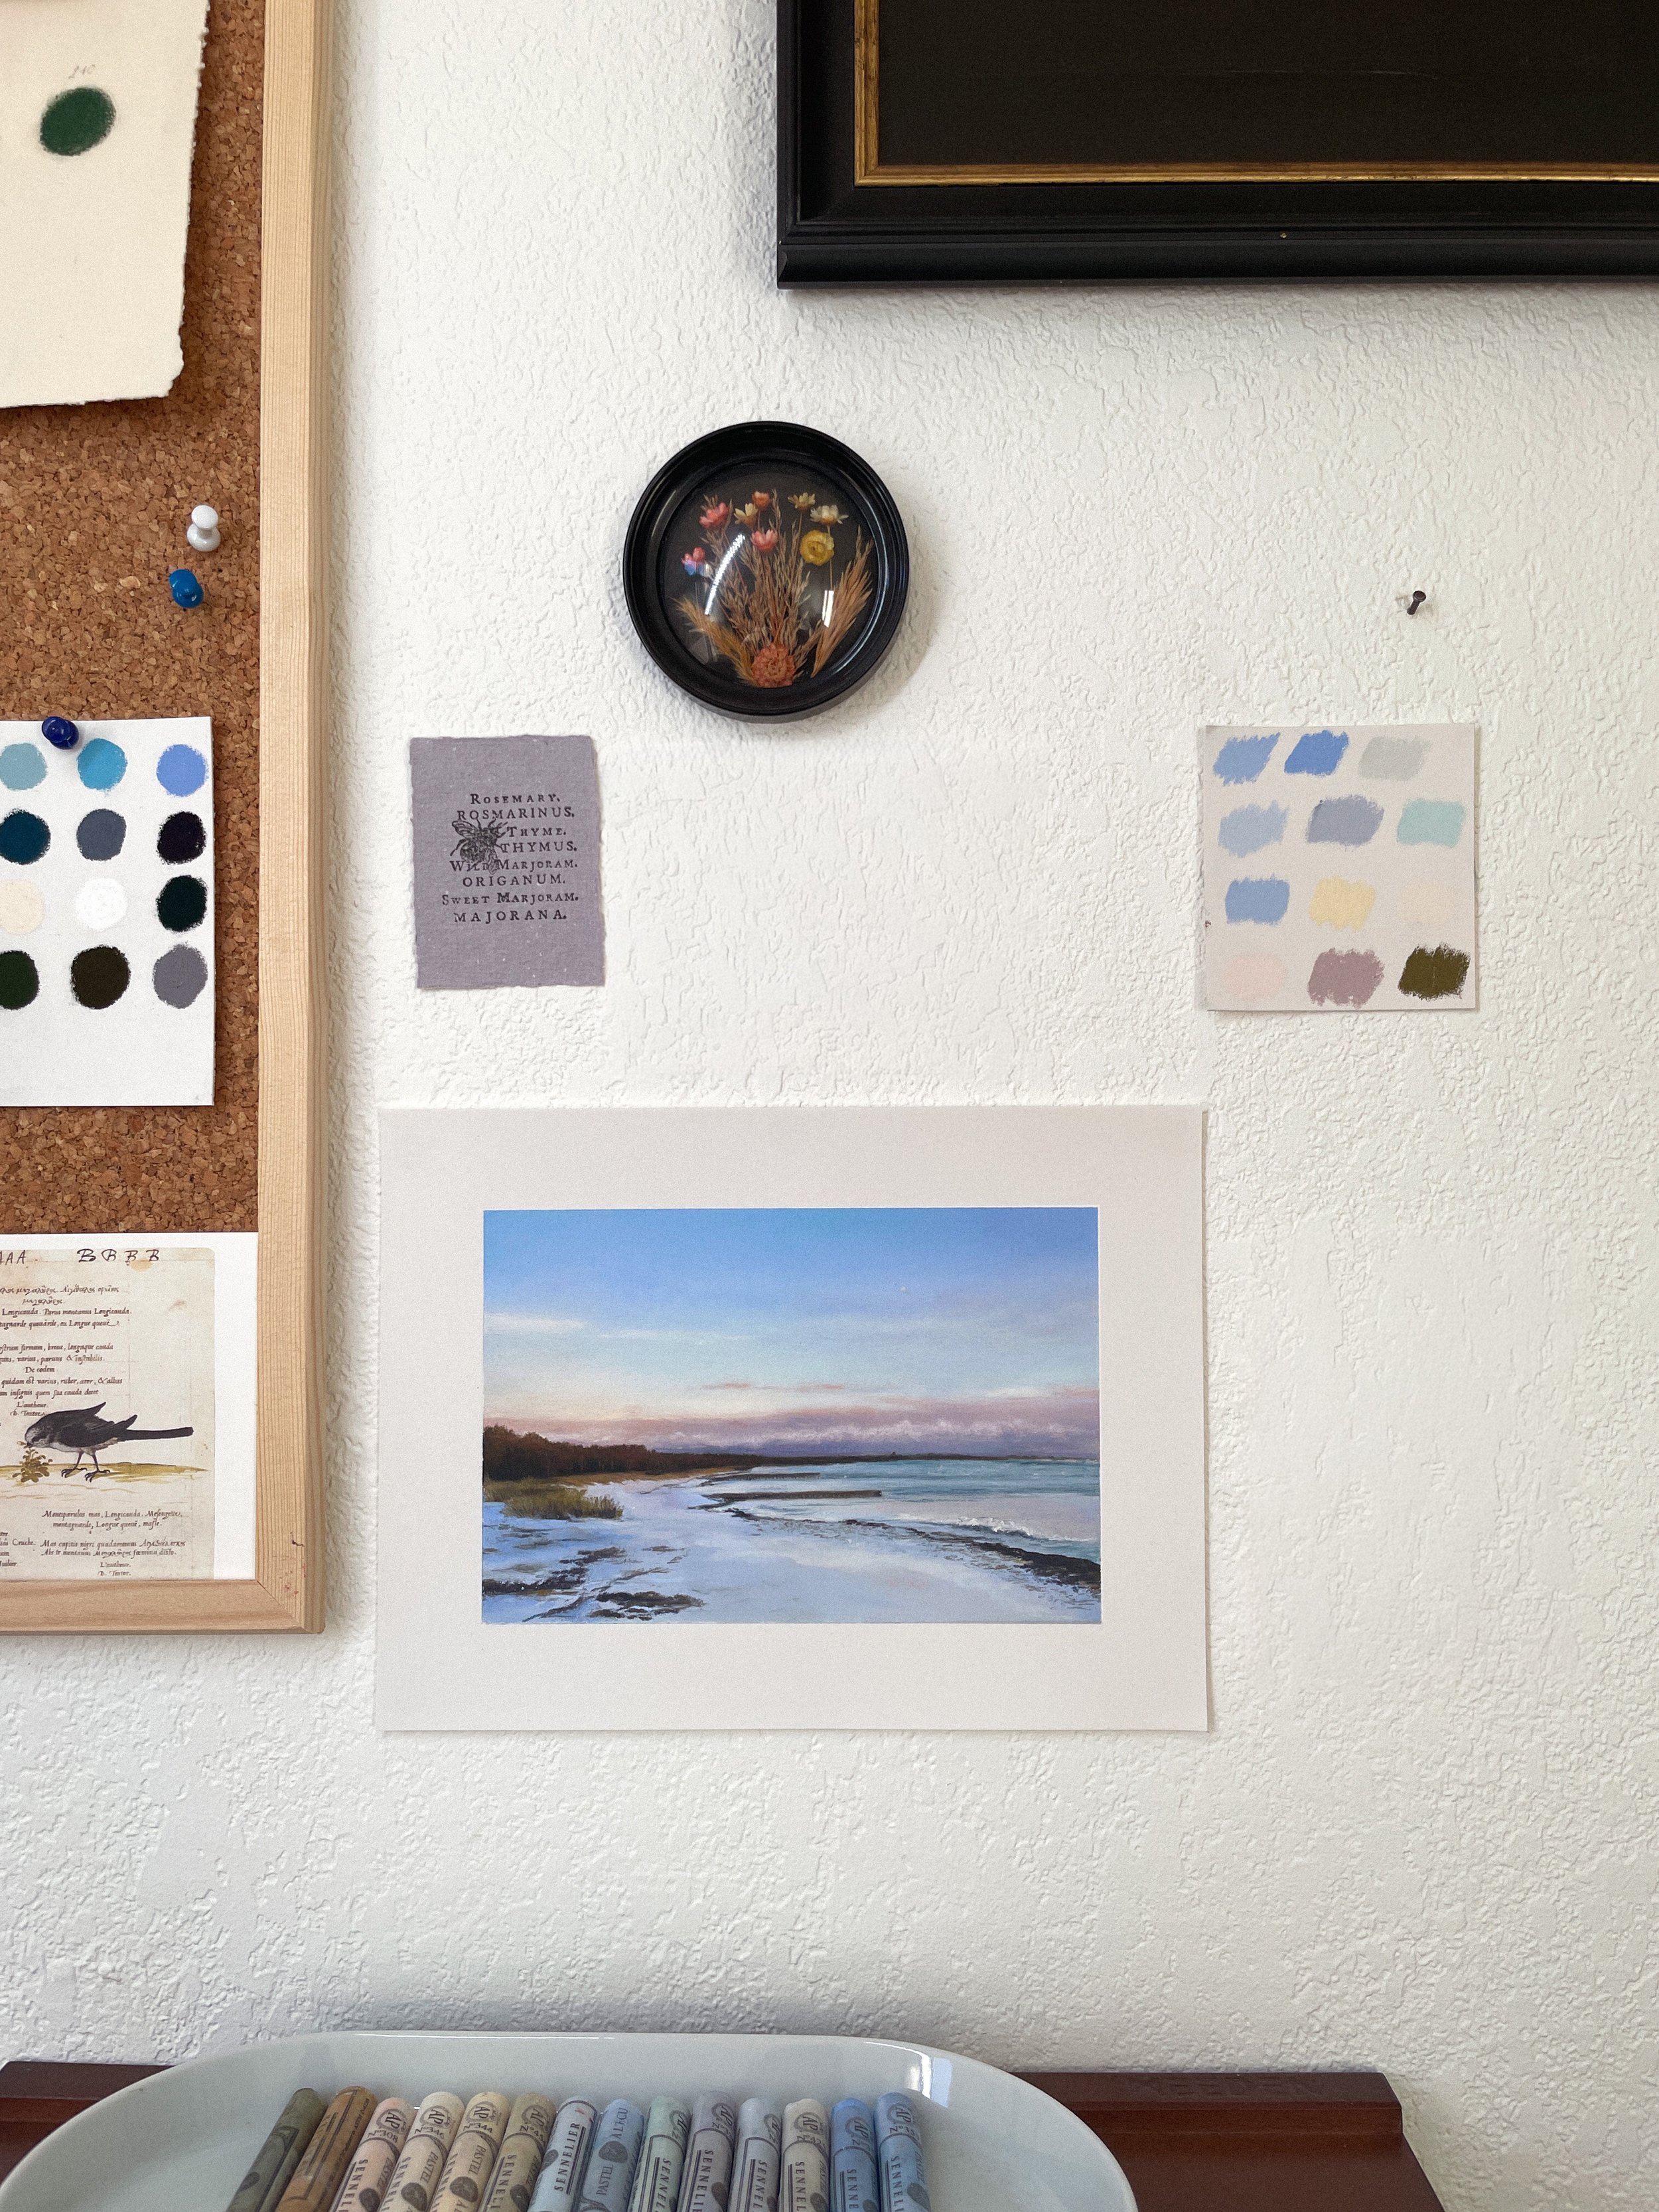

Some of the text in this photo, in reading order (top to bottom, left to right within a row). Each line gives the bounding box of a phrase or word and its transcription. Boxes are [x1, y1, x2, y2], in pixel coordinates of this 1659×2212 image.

[457, 807, 575, 821] ROSMARINUS.
[500, 842, 577, 853] THYMUS.
[463, 874, 566, 887] ORIGANUM.
[454, 910, 567, 924] MAJORANA.
[420, 2152, 439, 2183] PASTEL
[468, 2145, 486, 2175] PASTEL
[554, 2122, 581, 2191] SENNELIER
[595, 2164, 614, 2195] PASTEL
[655, 2158, 672, 2212] SENNEL
